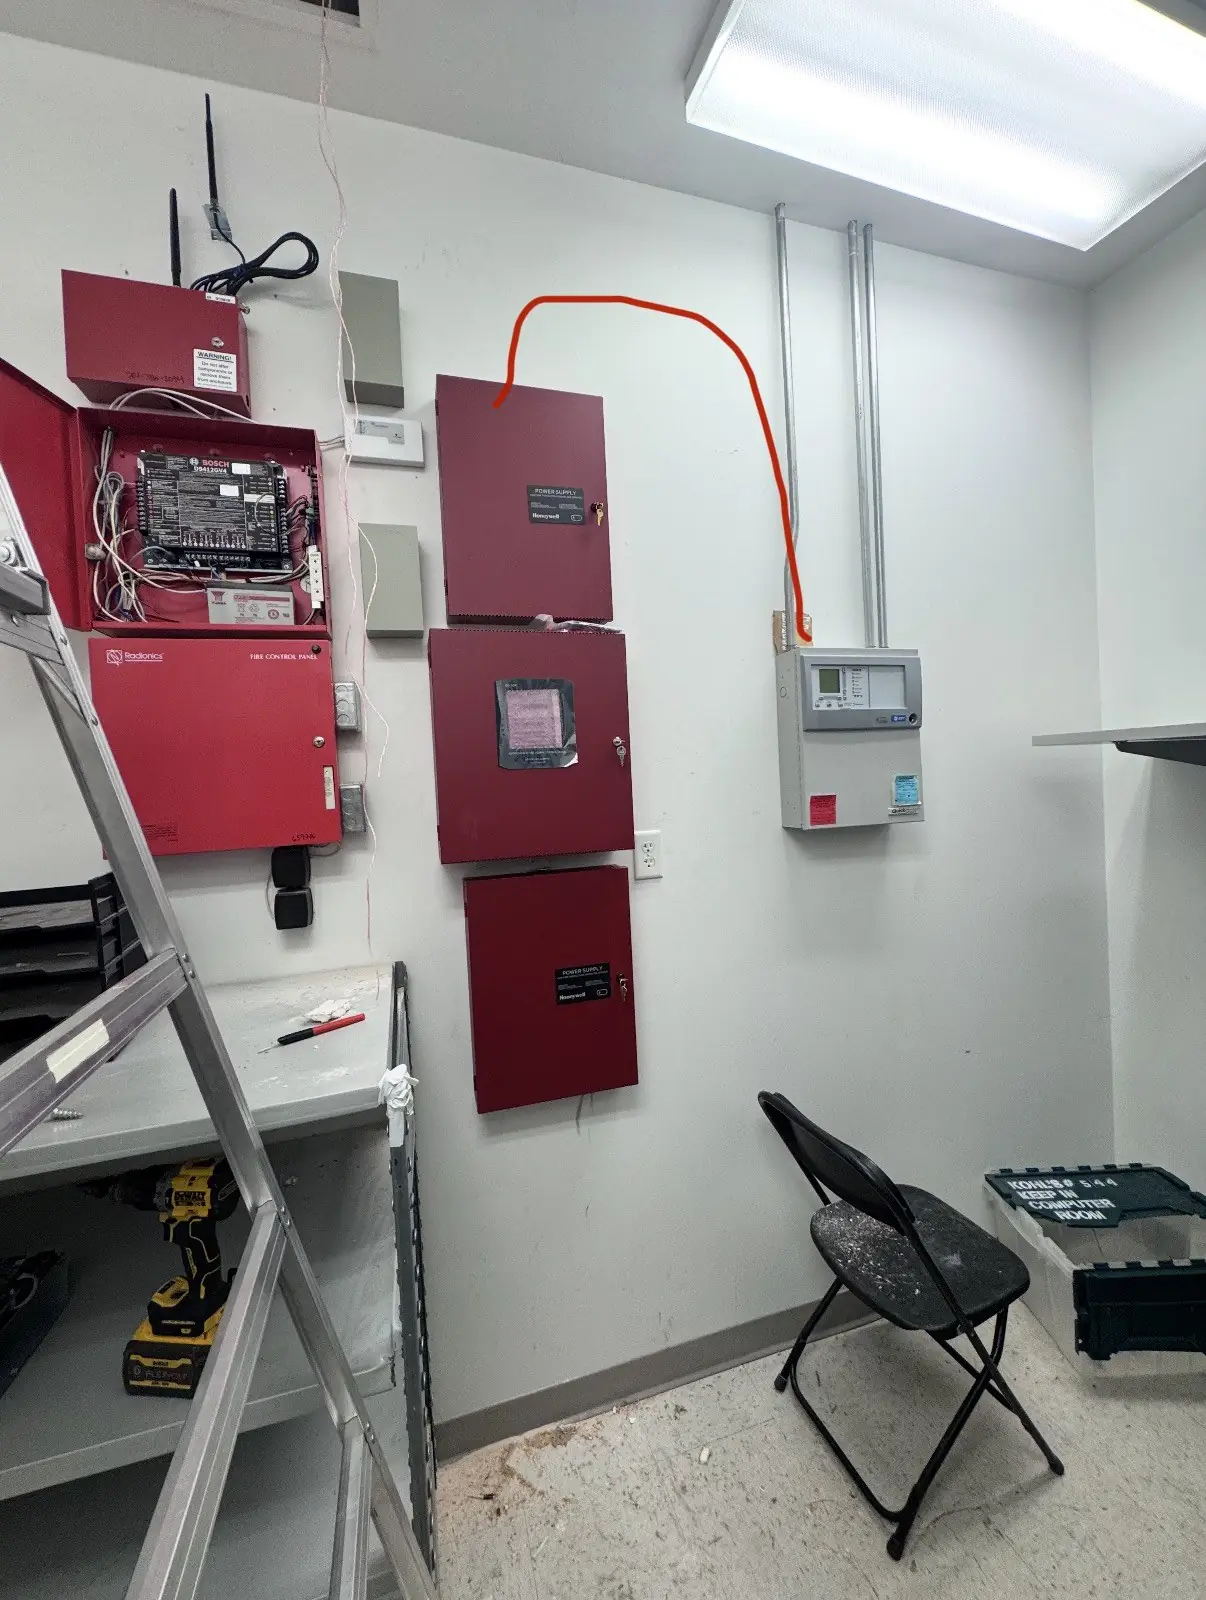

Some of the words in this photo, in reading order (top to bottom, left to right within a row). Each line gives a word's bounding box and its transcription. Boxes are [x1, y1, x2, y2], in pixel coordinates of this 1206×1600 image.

[197, 351, 232, 361] WARNING!
[202, 459, 229, 468] BOSCH
[532, 512, 560, 520] Honeywell
[124, 651, 163, 660] Radionics
[562, 968, 582, 976] POWER
[559, 992, 586, 1000] Honeywell
[1016, 1190, 1057, 1200] KEEP
[1057, 1189, 1080, 1199] IN
[1028, 1199, 1116, 1209] COMPUTER
[1053, 1210, 1108, 1220] ROOM
